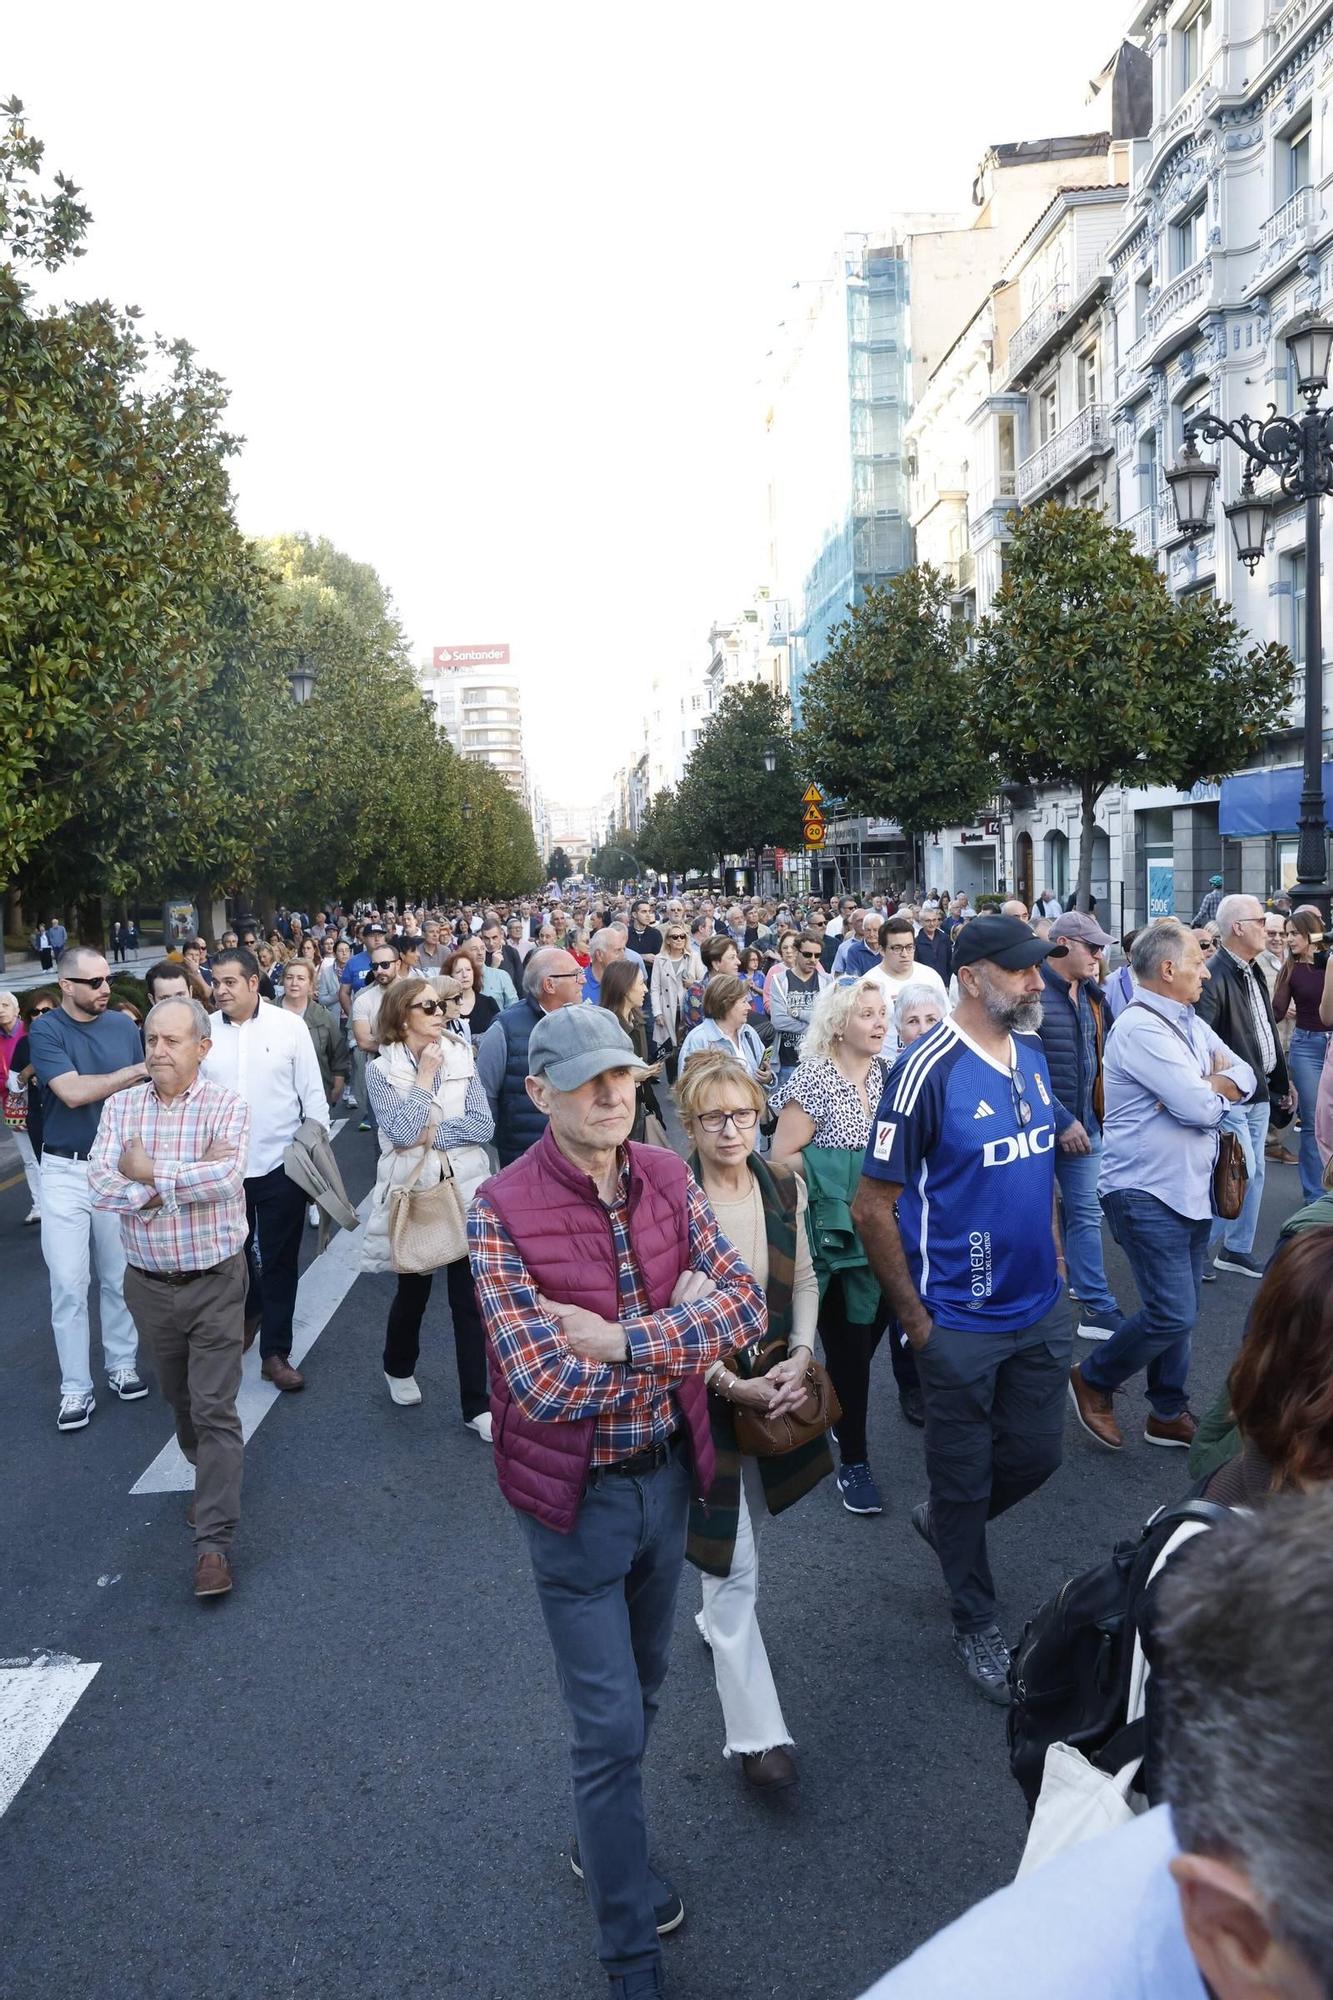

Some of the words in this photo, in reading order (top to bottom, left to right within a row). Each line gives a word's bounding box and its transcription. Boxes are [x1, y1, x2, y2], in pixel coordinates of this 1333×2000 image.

[452, 649, 505, 661] Santander
[809, 828, 820, 836] 20
[1151, 899, 1169, 912] 500€
[983, 1122, 1056, 1168] DIG
[983, 1231, 992, 1259] CAMINO
[969, 1231, 985, 1297] OVIEDO
